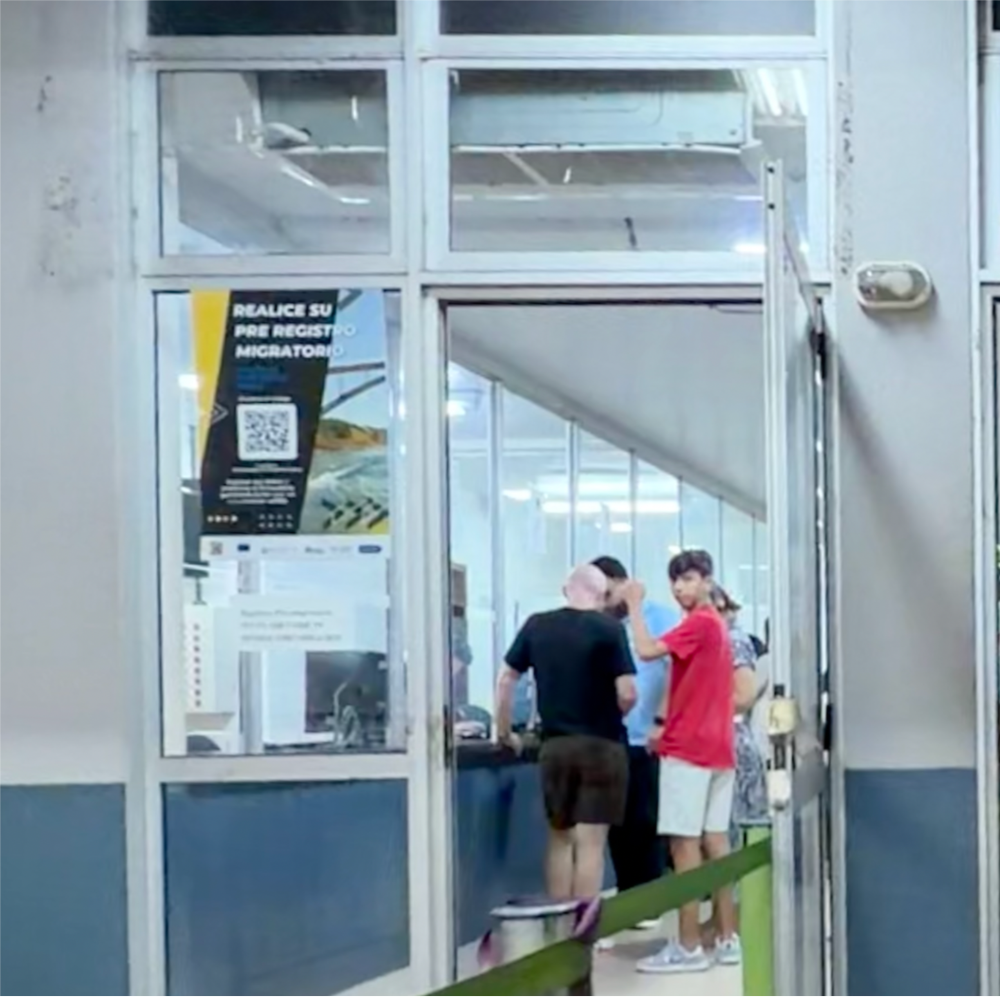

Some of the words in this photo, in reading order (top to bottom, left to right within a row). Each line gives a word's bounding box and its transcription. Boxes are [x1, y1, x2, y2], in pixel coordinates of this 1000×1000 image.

[233, 303, 306, 318] REALICE
[308, 303, 333, 318] SU
[234, 323, 270, 338] PRE
[272, 323, 357, 338] REGISTRO
[235, 344, 345, 359] MIGRATORIO
